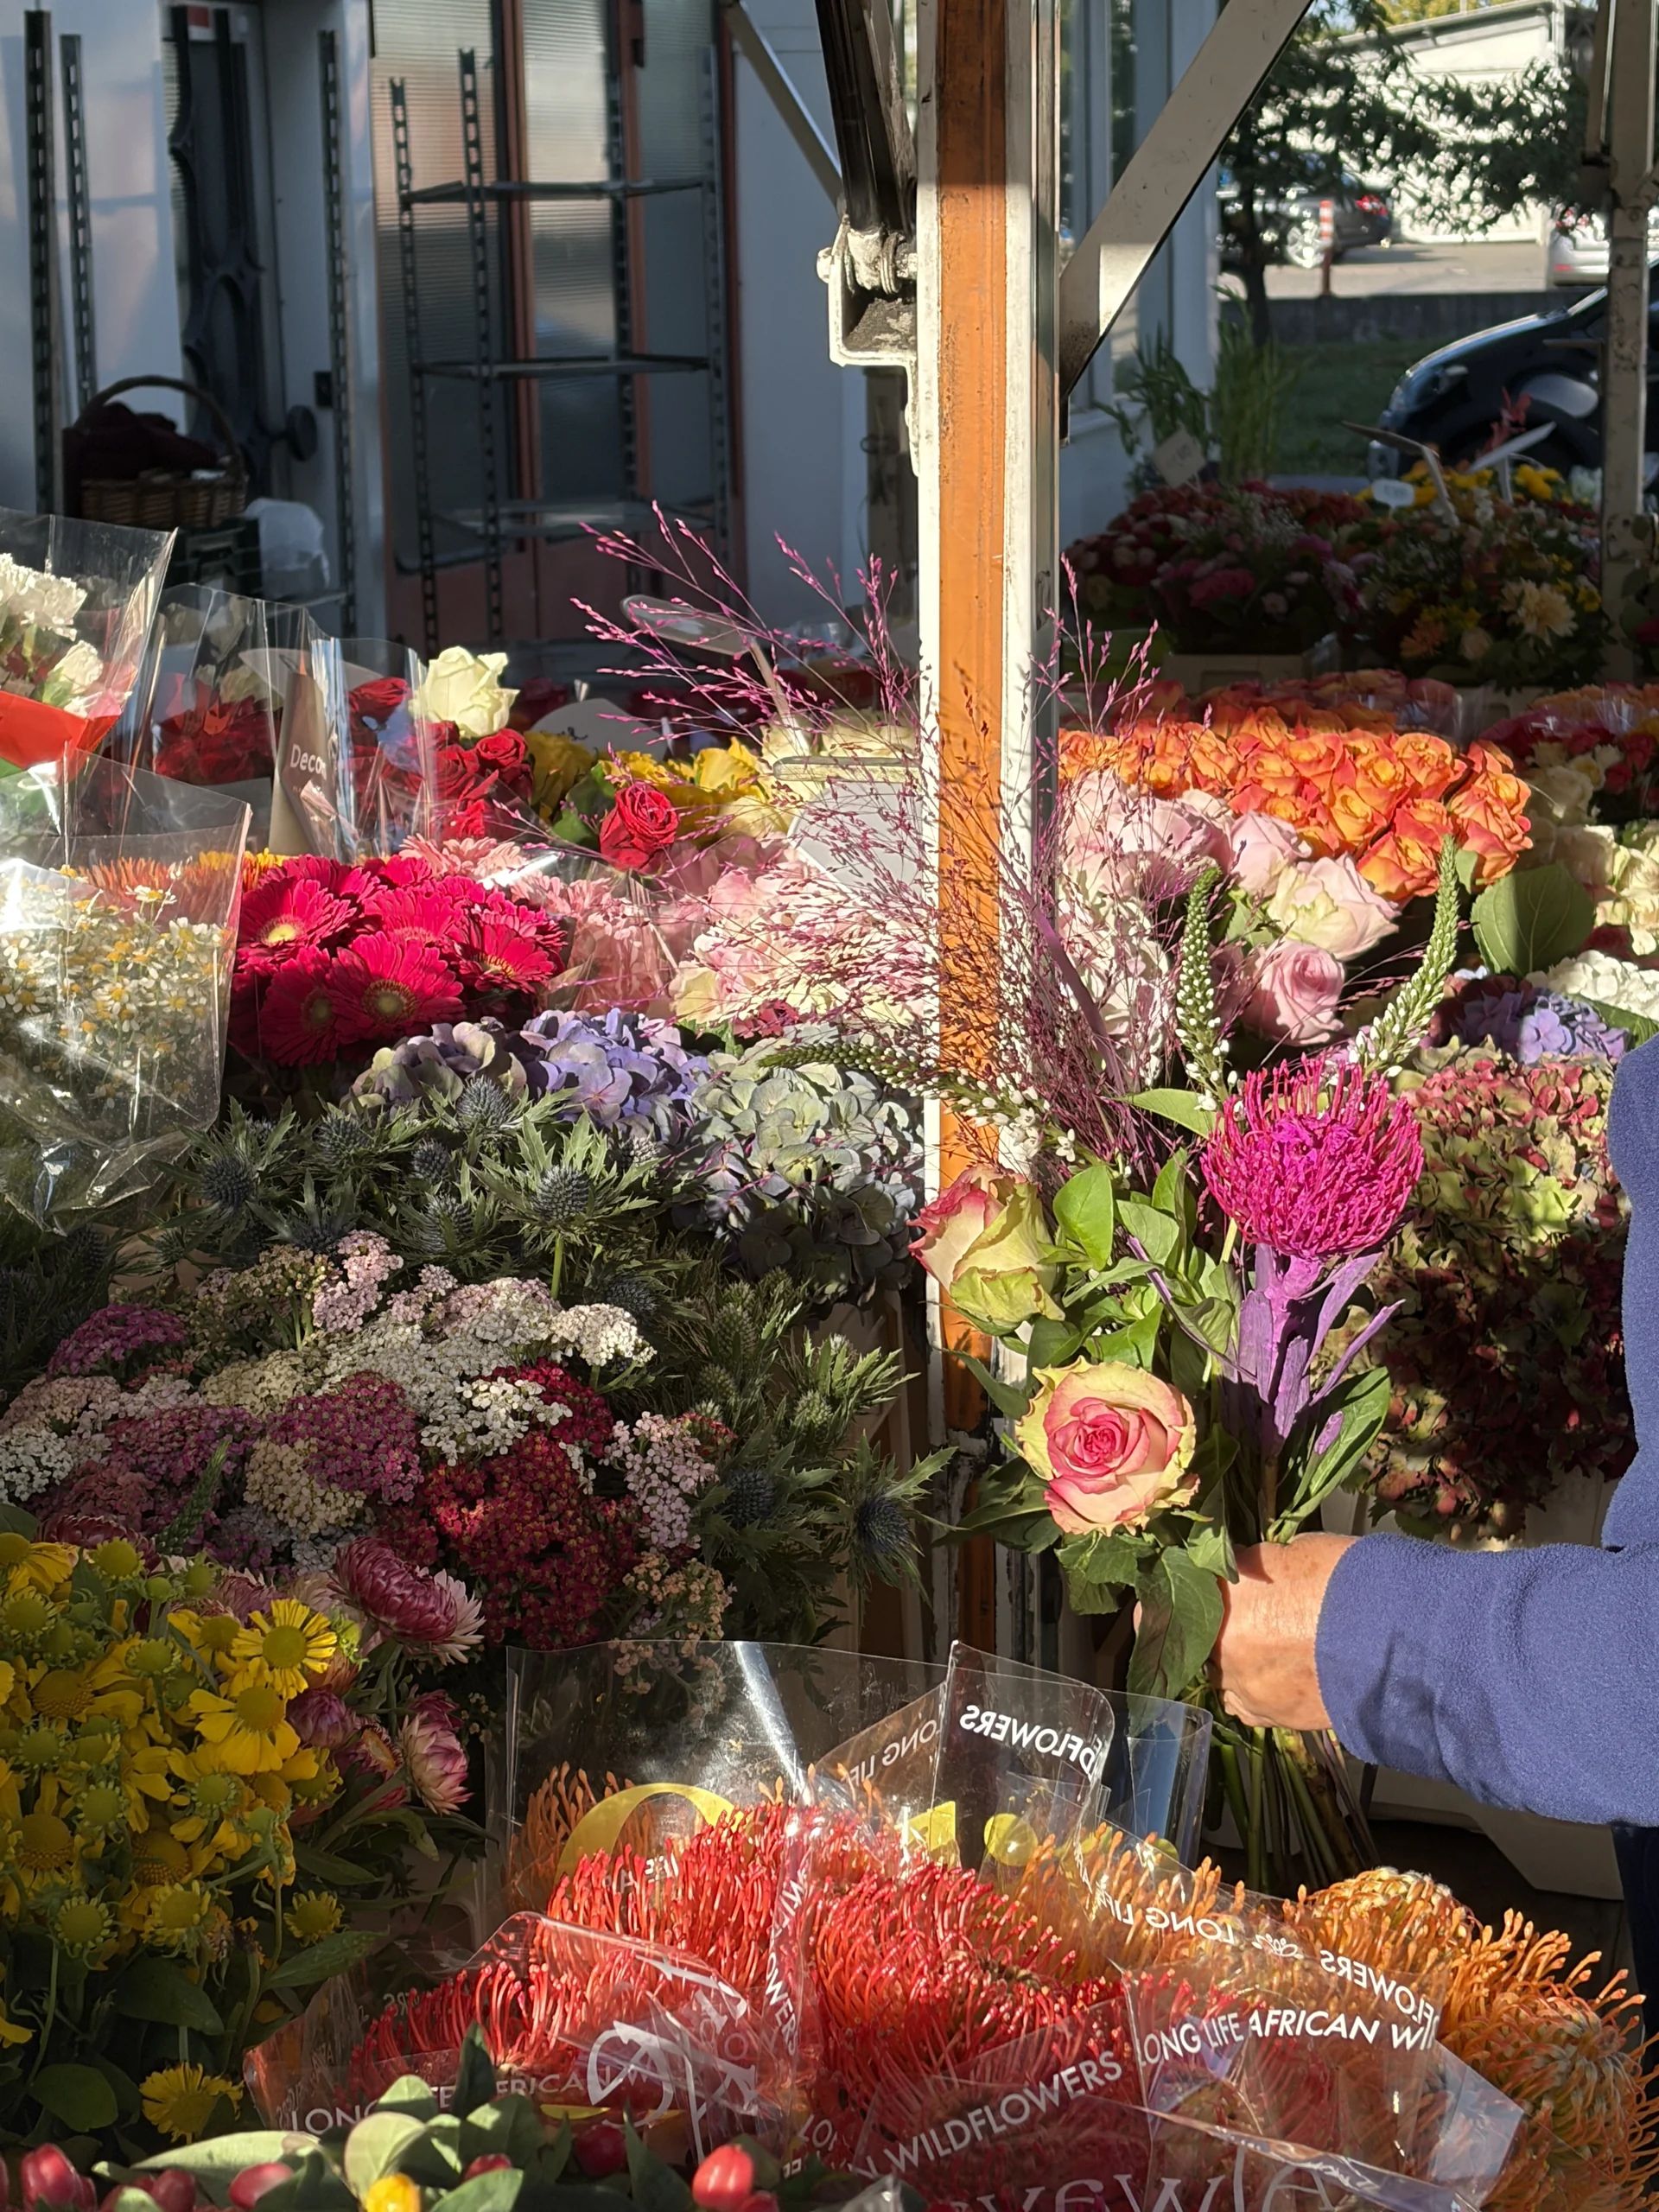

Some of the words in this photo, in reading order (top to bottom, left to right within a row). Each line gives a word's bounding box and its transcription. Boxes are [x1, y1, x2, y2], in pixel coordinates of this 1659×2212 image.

[1203, 2012, 1244, 2049] LIFE
[1249, 2009, 1380, 2044] AFRICAN
[883, 2050, 1122, 2173] WILDFLOWERS
